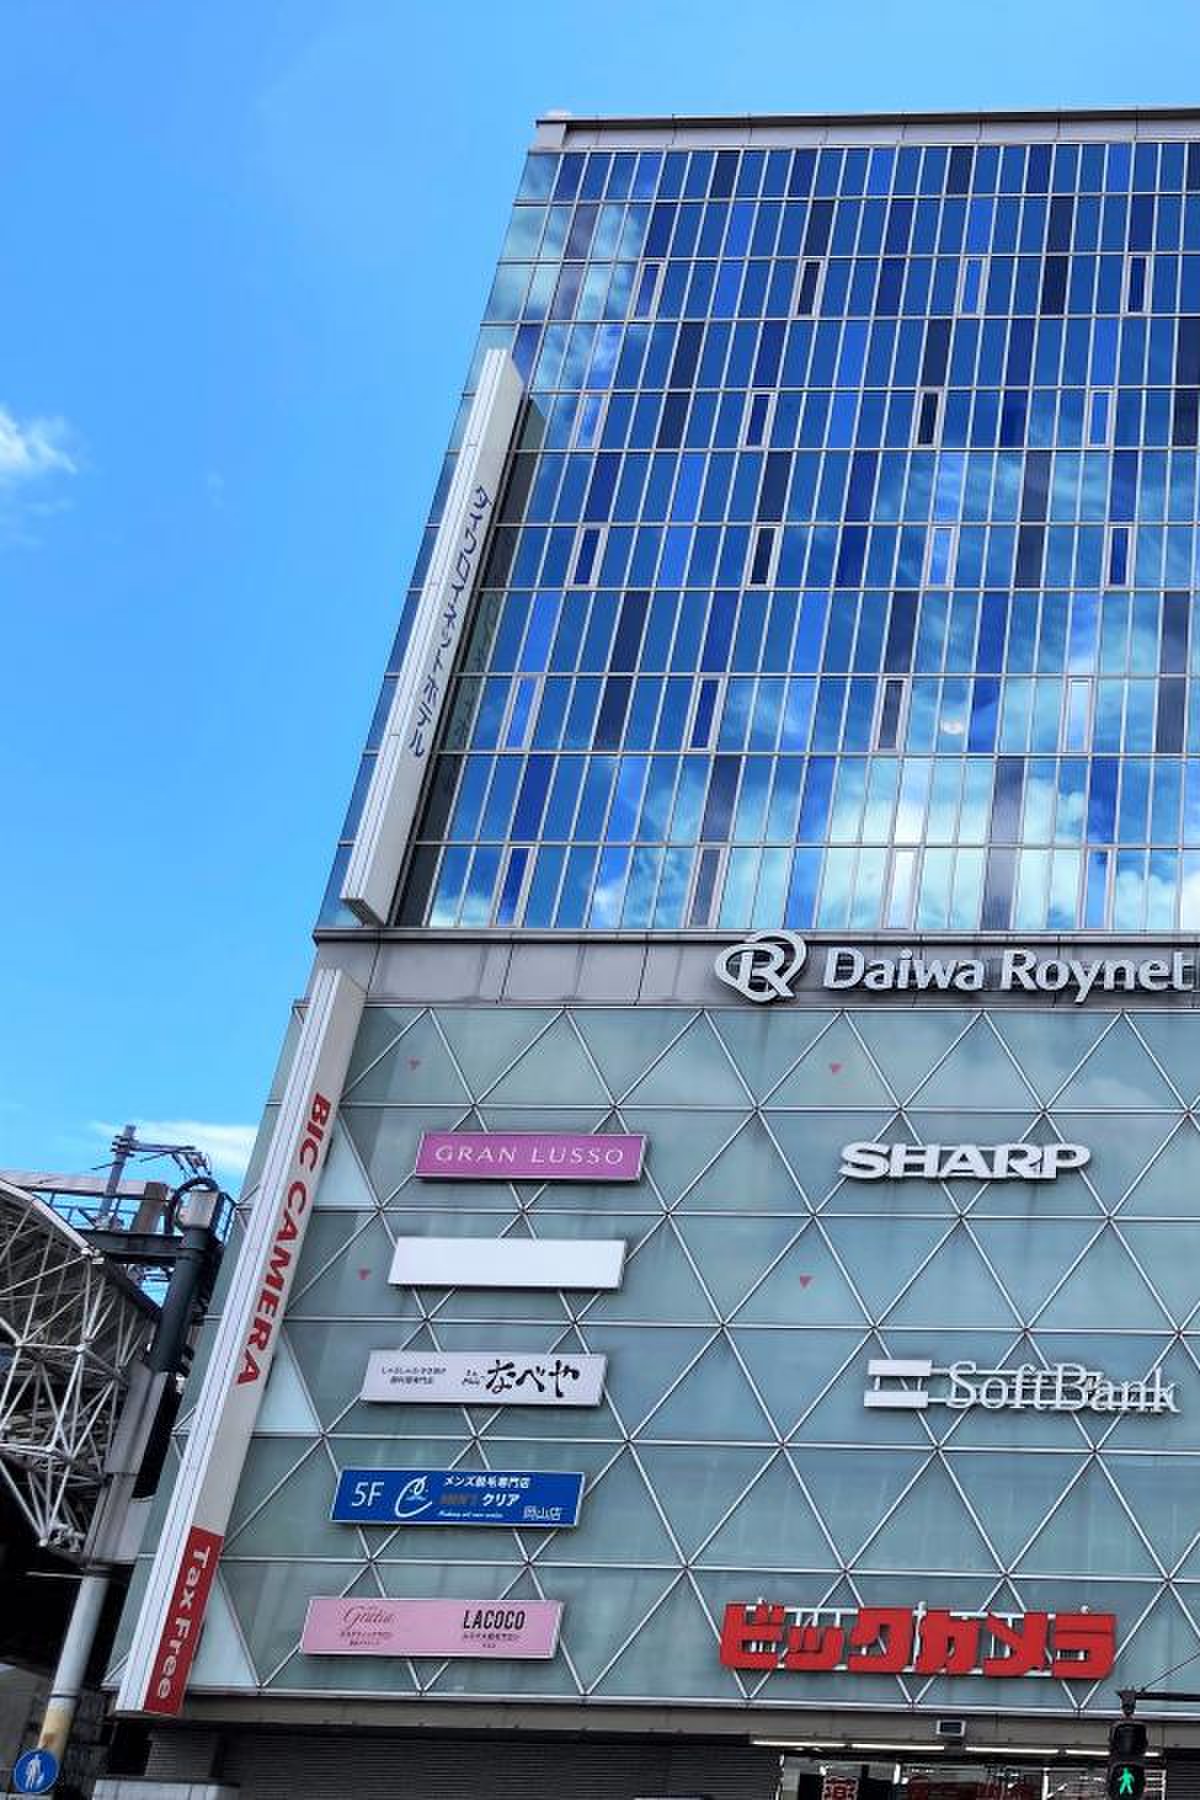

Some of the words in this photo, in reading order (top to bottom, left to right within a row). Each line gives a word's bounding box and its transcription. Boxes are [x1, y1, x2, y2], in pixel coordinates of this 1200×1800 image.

[823, 946, 986, 991] Daiwa
[1002, 949, 1195, 1004] Roynet
[300, 1092, 331, 1172] BIC
[435, 1145, 518, 1164] GRAN
[531, 1147, 624, 1165] LUSSO
[838, 1141, 1092, 1181] SHARP
[237, 1181, 307, 1386] CAMERA
[486, 1359, 580, 1398] なべや
[946, 1360, 1182, 1413] SoftBank
[352, 1481, 384, 1507] 5F
[482, 1492, 521, 1507] クリア
[179, 1546, 211, 1610] Tax
[464, 1609, 526, 1630] LACOCO
[720, 1603, 1117, 1680] ビックカメラ
[158, 1617, 193, 1698] Free
